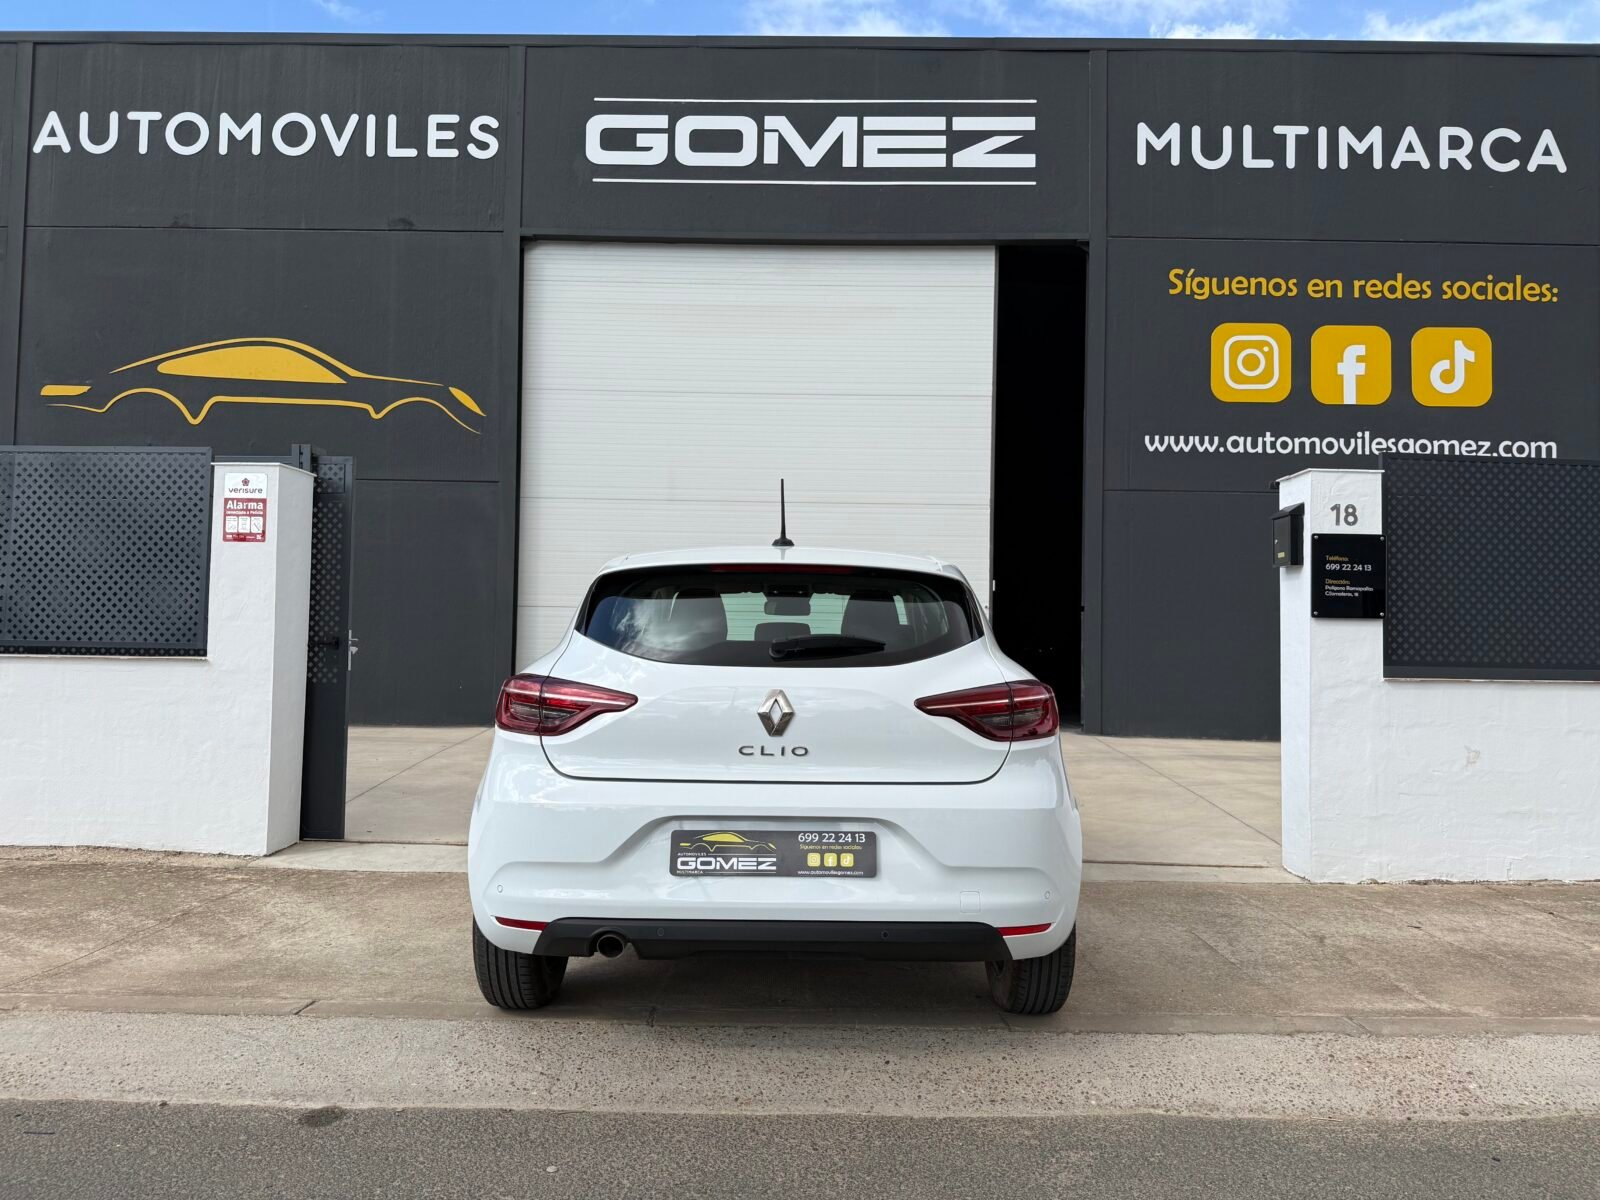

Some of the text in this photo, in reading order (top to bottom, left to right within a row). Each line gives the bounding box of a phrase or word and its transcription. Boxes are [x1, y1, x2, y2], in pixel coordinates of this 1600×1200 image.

[32, 110, 500, 160] AUTOMOVILES
[585, 114, 1037, 168] GOMEZ
[1136, 121, 1568, 174] MULTIMARCA
[1168, 267, 1559, 303] Síguenos en redes sociales:
[226, 500, 264, 510] Alarma
[1330, 503, 1359, 527] 18
[1325, 563, 1340, 571] 699
[1341, 563, 1352, 571] 22
[738, 745, 809, 757] CLIO
[798, 832, 866, 843] 699 22 24 13
[676, 857, 777, 870] GOMEZ
